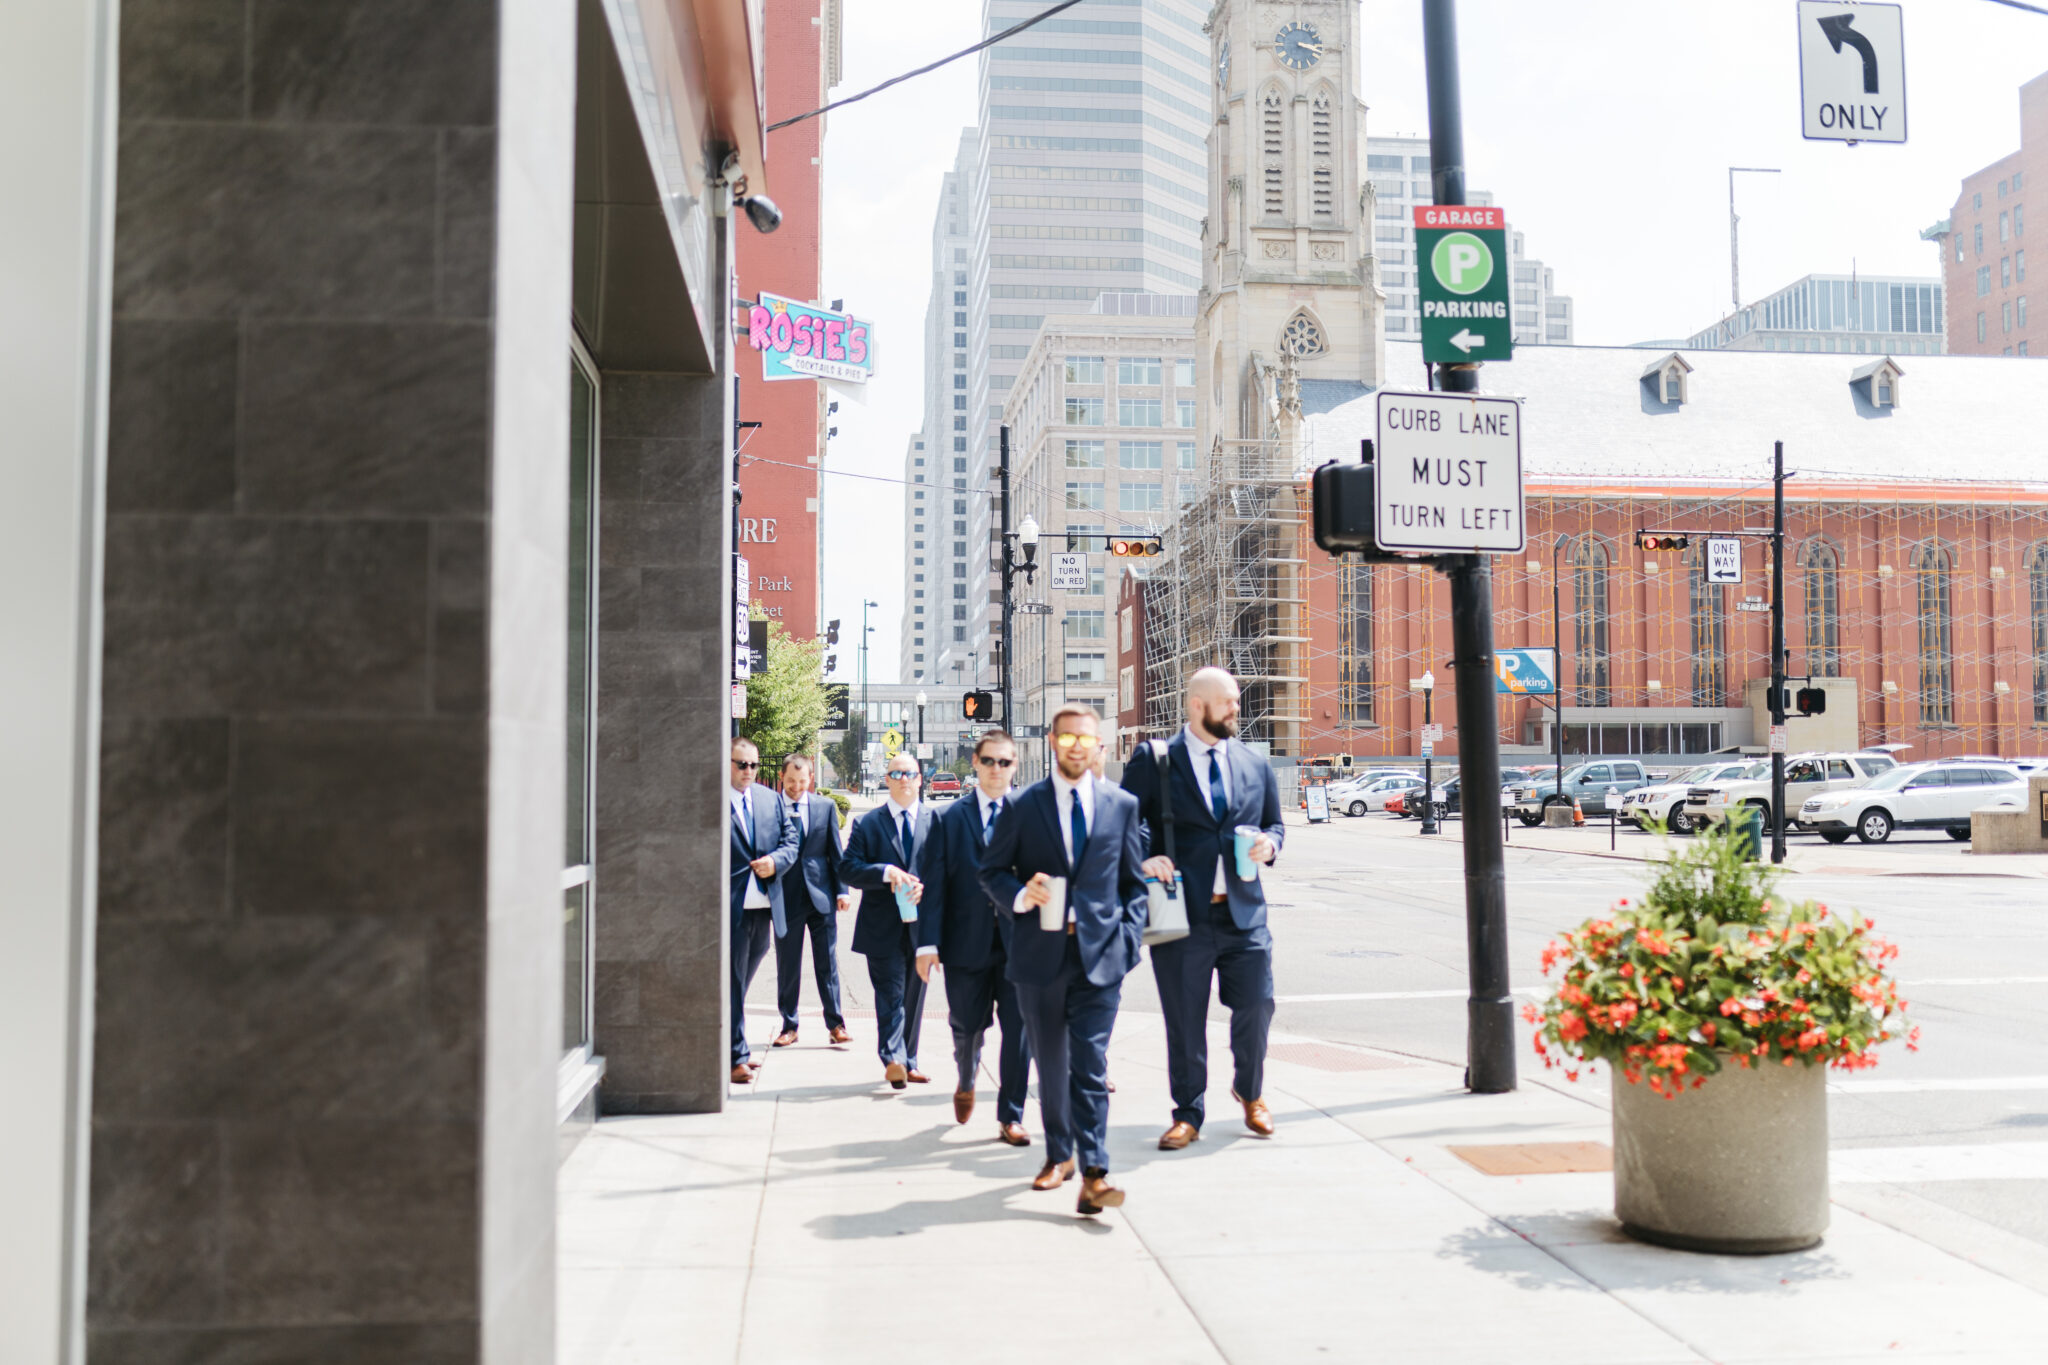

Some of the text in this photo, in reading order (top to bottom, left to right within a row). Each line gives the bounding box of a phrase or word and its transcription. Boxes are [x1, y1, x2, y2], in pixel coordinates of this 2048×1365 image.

[1820, 103, 1888, 131] ONLY
[1425, 210, 1495, 226] GARAGE
[1449, 243, 1480, 285] P
[1423, 301, 1507, 319] PARKING
[1388, 407, 1510, 436] CURB LANE
[1412, 457, 1487, 487] MUST
[1389, 504, 1512, 531] TURN LEFT
[738, 518, 777, 543] RE
[1713, 543, 1735, 555] ONE
[1062, 557, 1076, 565] NO
[1713, 557, 1735, 568] WAY
[1058, 567, 1080, 575] TURN
[758, 576, 792, 591] Park
[1054, 577, 1084, 585] ON RED
[1496, 654, 1520, 679] P
[1510, 677, 1548, 689] parking
